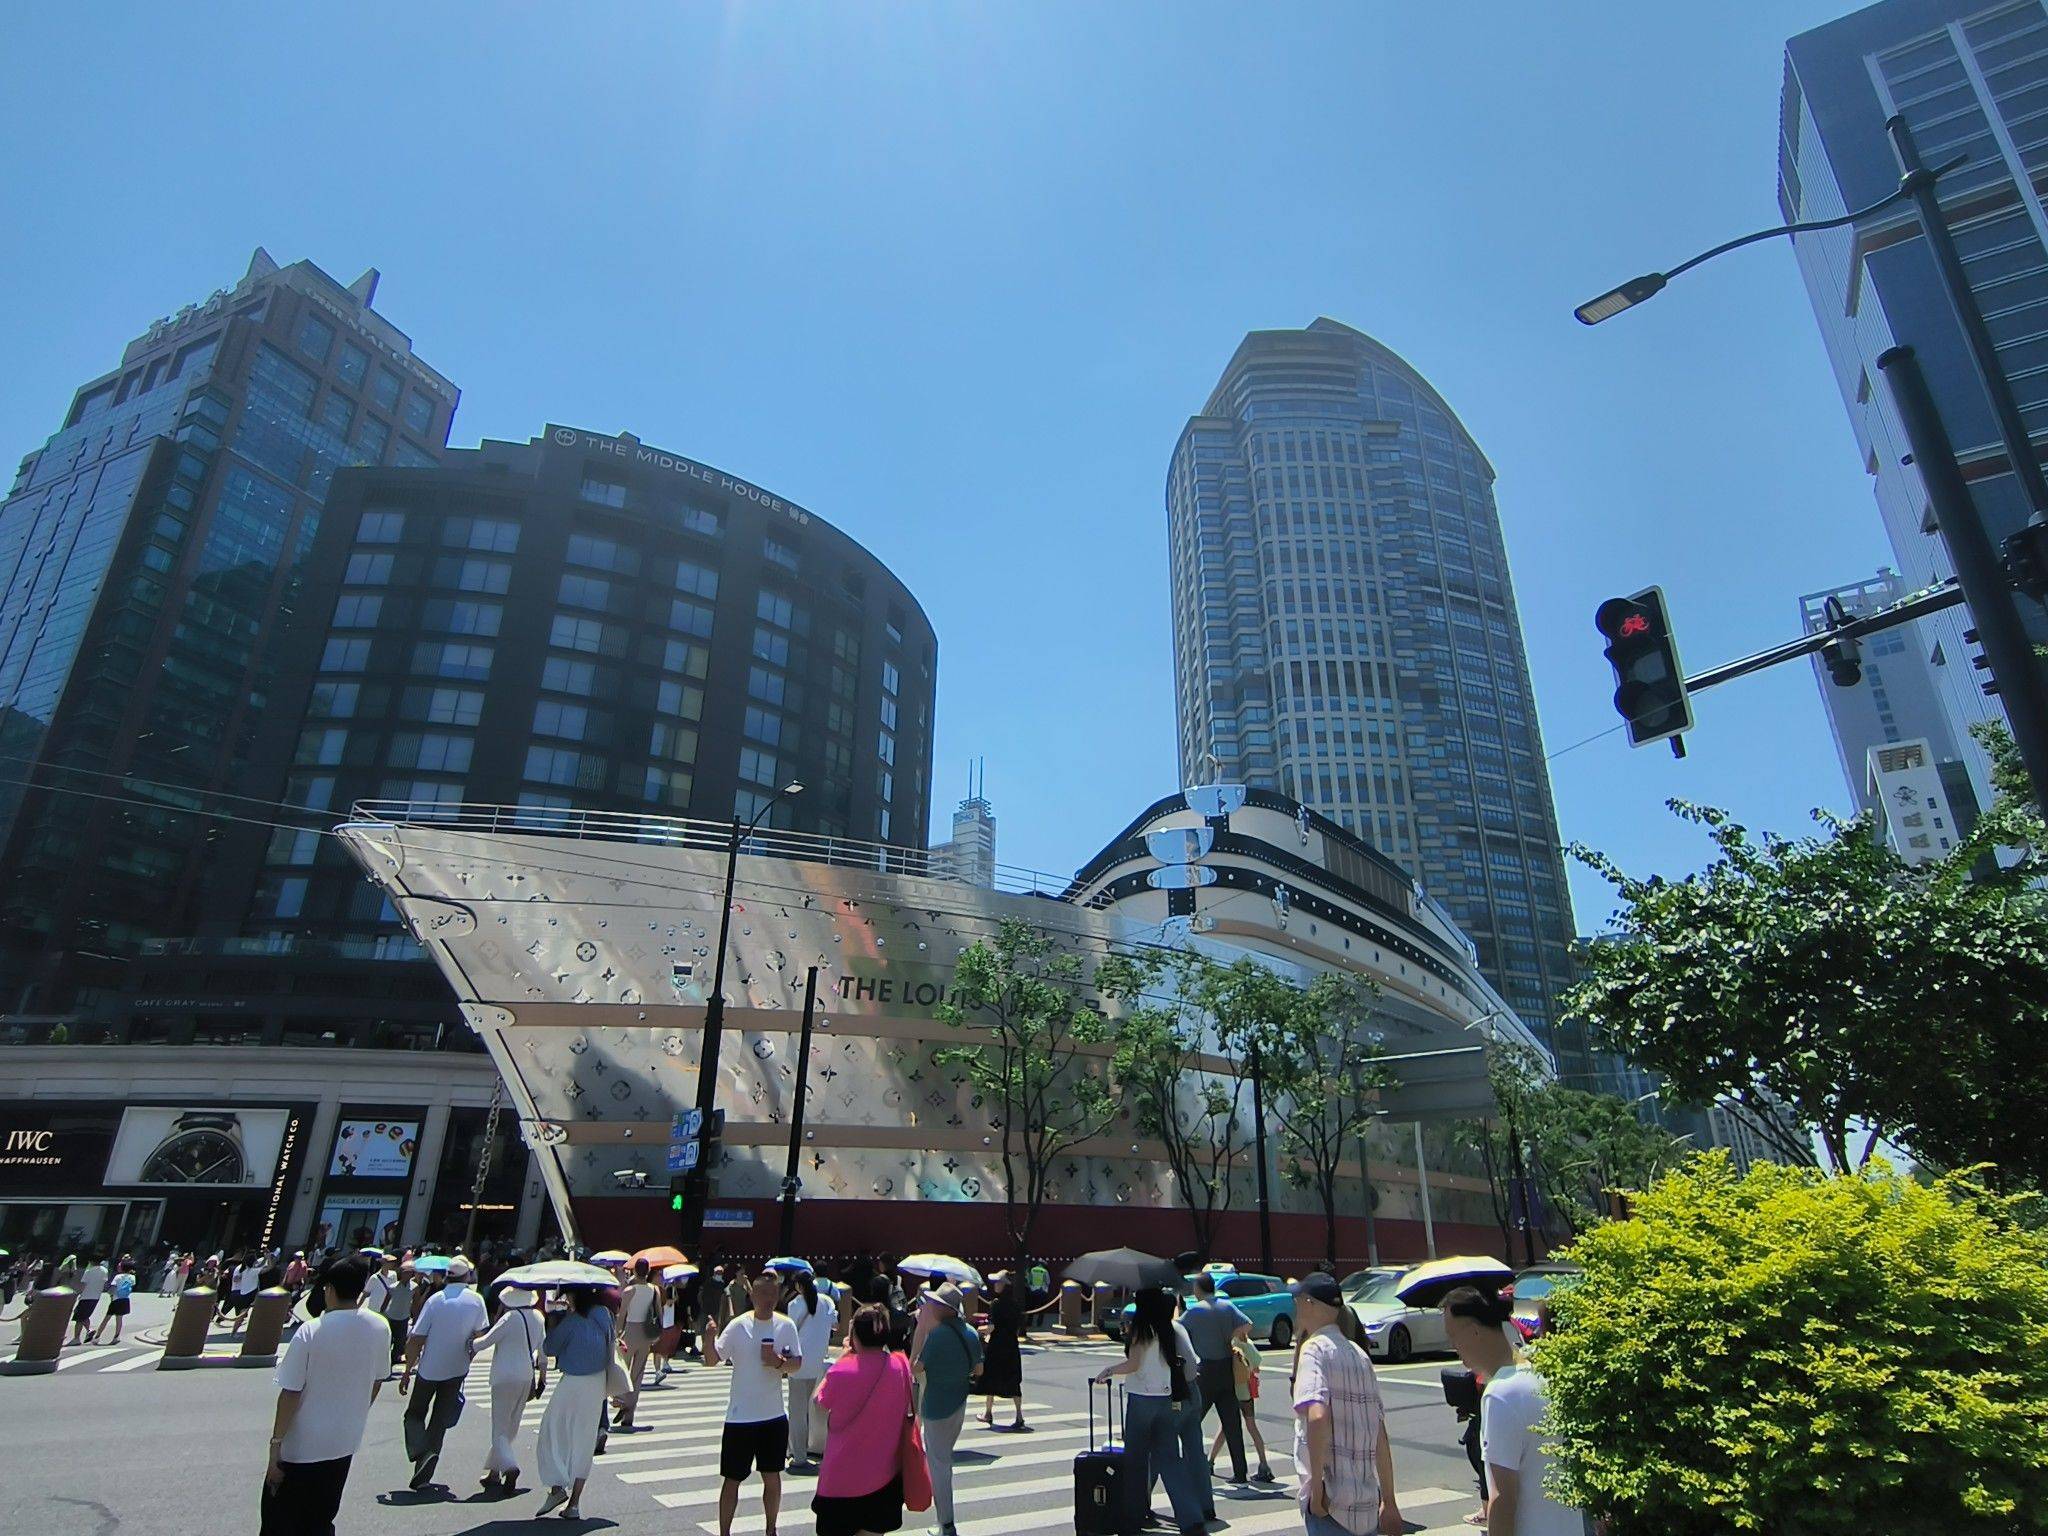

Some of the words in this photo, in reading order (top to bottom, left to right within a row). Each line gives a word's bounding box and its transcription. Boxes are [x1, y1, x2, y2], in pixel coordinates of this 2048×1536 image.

[585, 436, 628, 457] THE
[636, 449, 714, 484] MIDDLE
[721, 478, 781, 512] HOUSE
[839, 975, 893, 1003] THE
[5, 1130, 53, 1151] IWC
[260, 1174, 286, 1252] TERNATIONAL
[280, 1135, 296, 1170] WATCH
